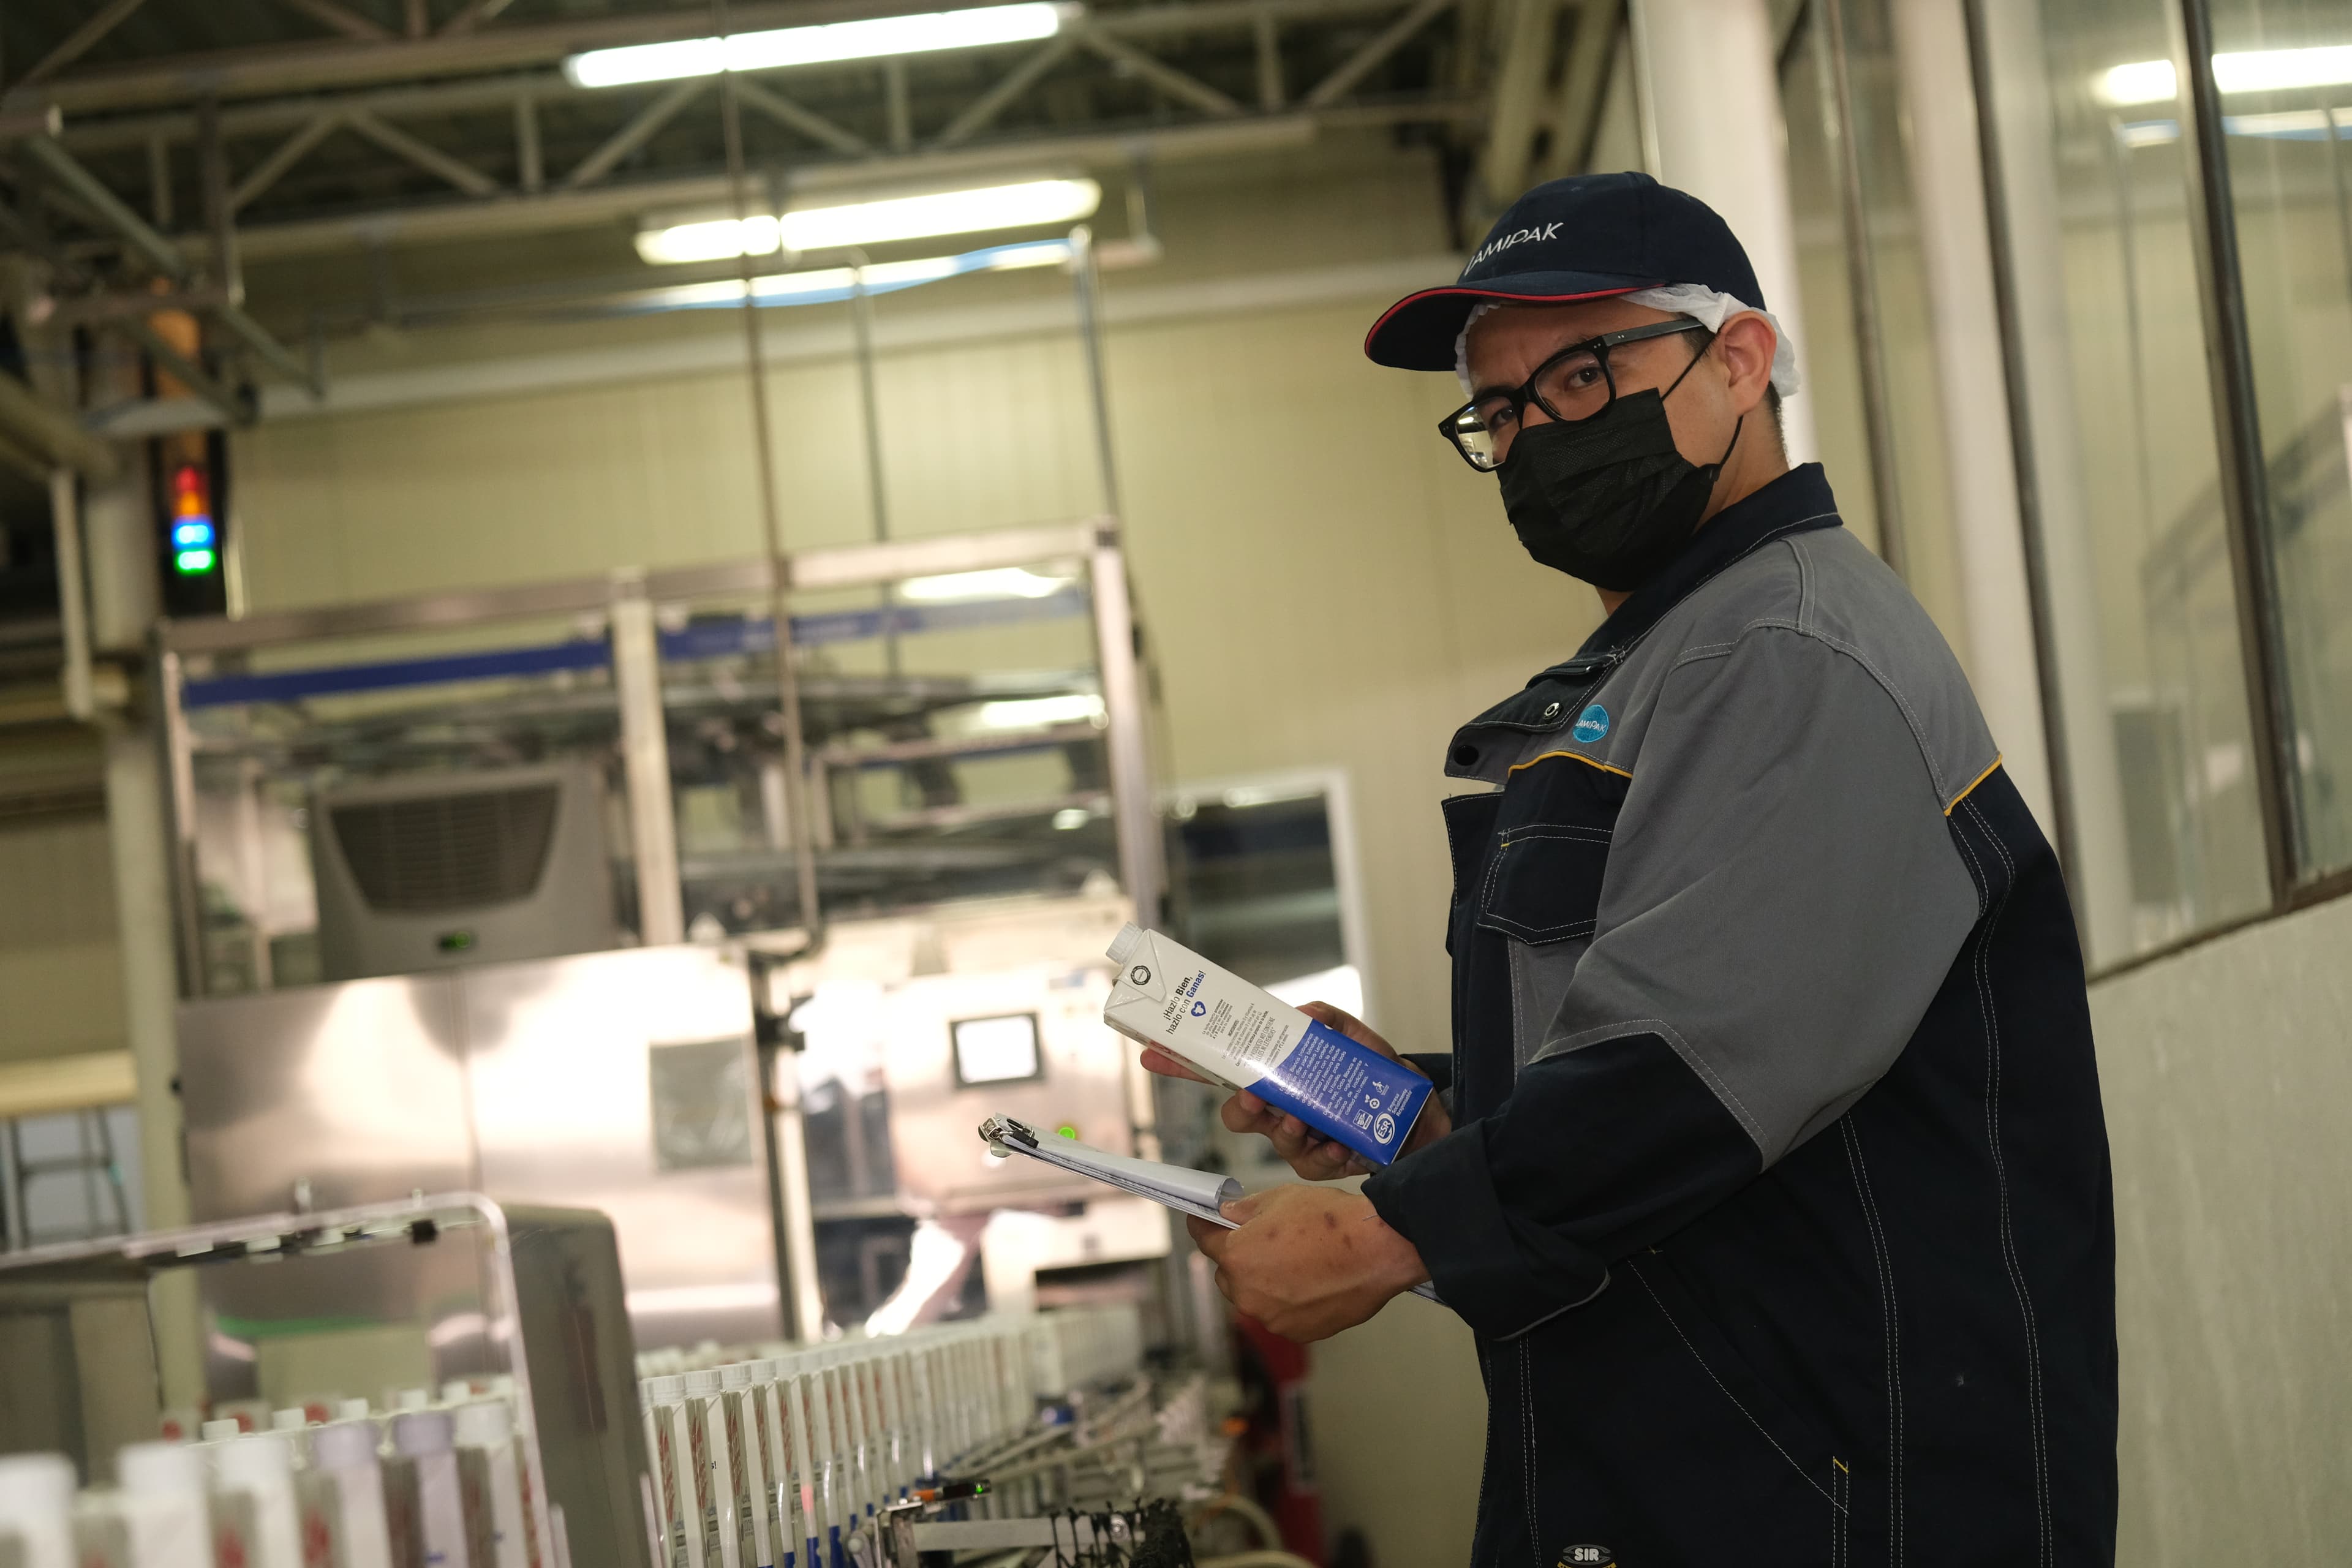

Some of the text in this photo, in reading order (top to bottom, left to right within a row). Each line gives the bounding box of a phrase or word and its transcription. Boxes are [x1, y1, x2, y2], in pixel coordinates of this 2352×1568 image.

[1163, 976, 1193, 1020] ¡Hazlo Bien,
[1166, 970, 1205, 1035] hazlo con Ganas!
[1262, 1016, 1275, 1034] CONTIENE
[1376, 1120, 1391, 1137] ESR
[1574, 1548, 1599, 1561] SIR
